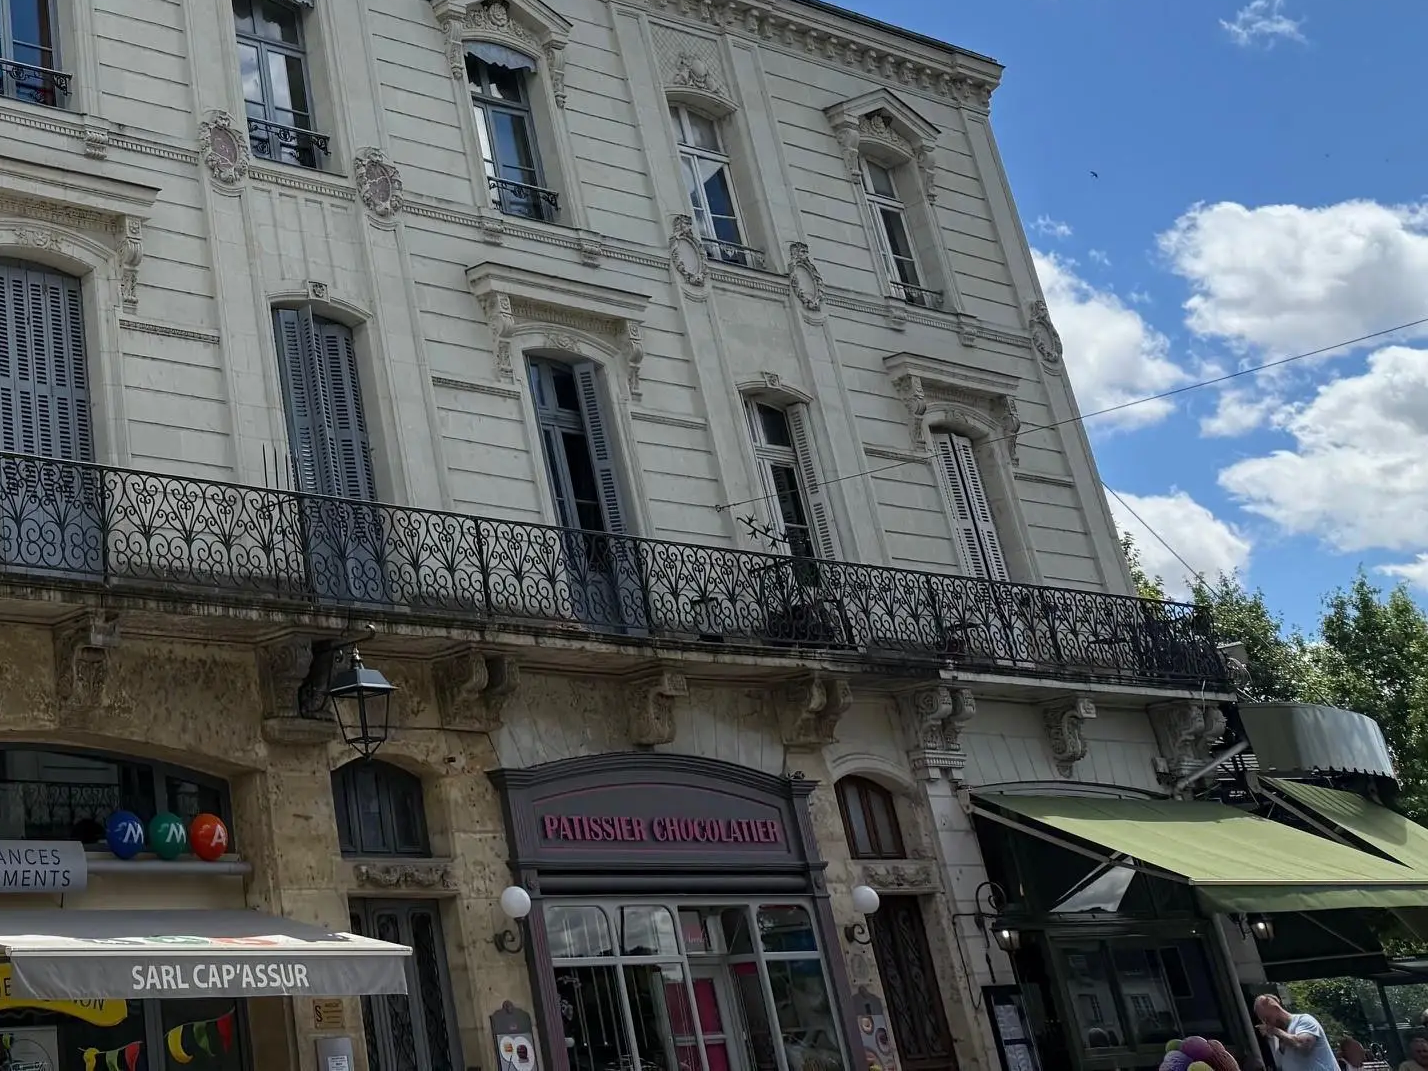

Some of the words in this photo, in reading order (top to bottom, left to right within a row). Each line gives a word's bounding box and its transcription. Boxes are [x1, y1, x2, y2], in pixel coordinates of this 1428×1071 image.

[544, 815, 646, 841] PATISSIER
[652, 817, 782, 843] CHOCOLATIER
[132, 965, 190, 990] SARL
[192, 963, 310, 989] CAP'ASSUR
